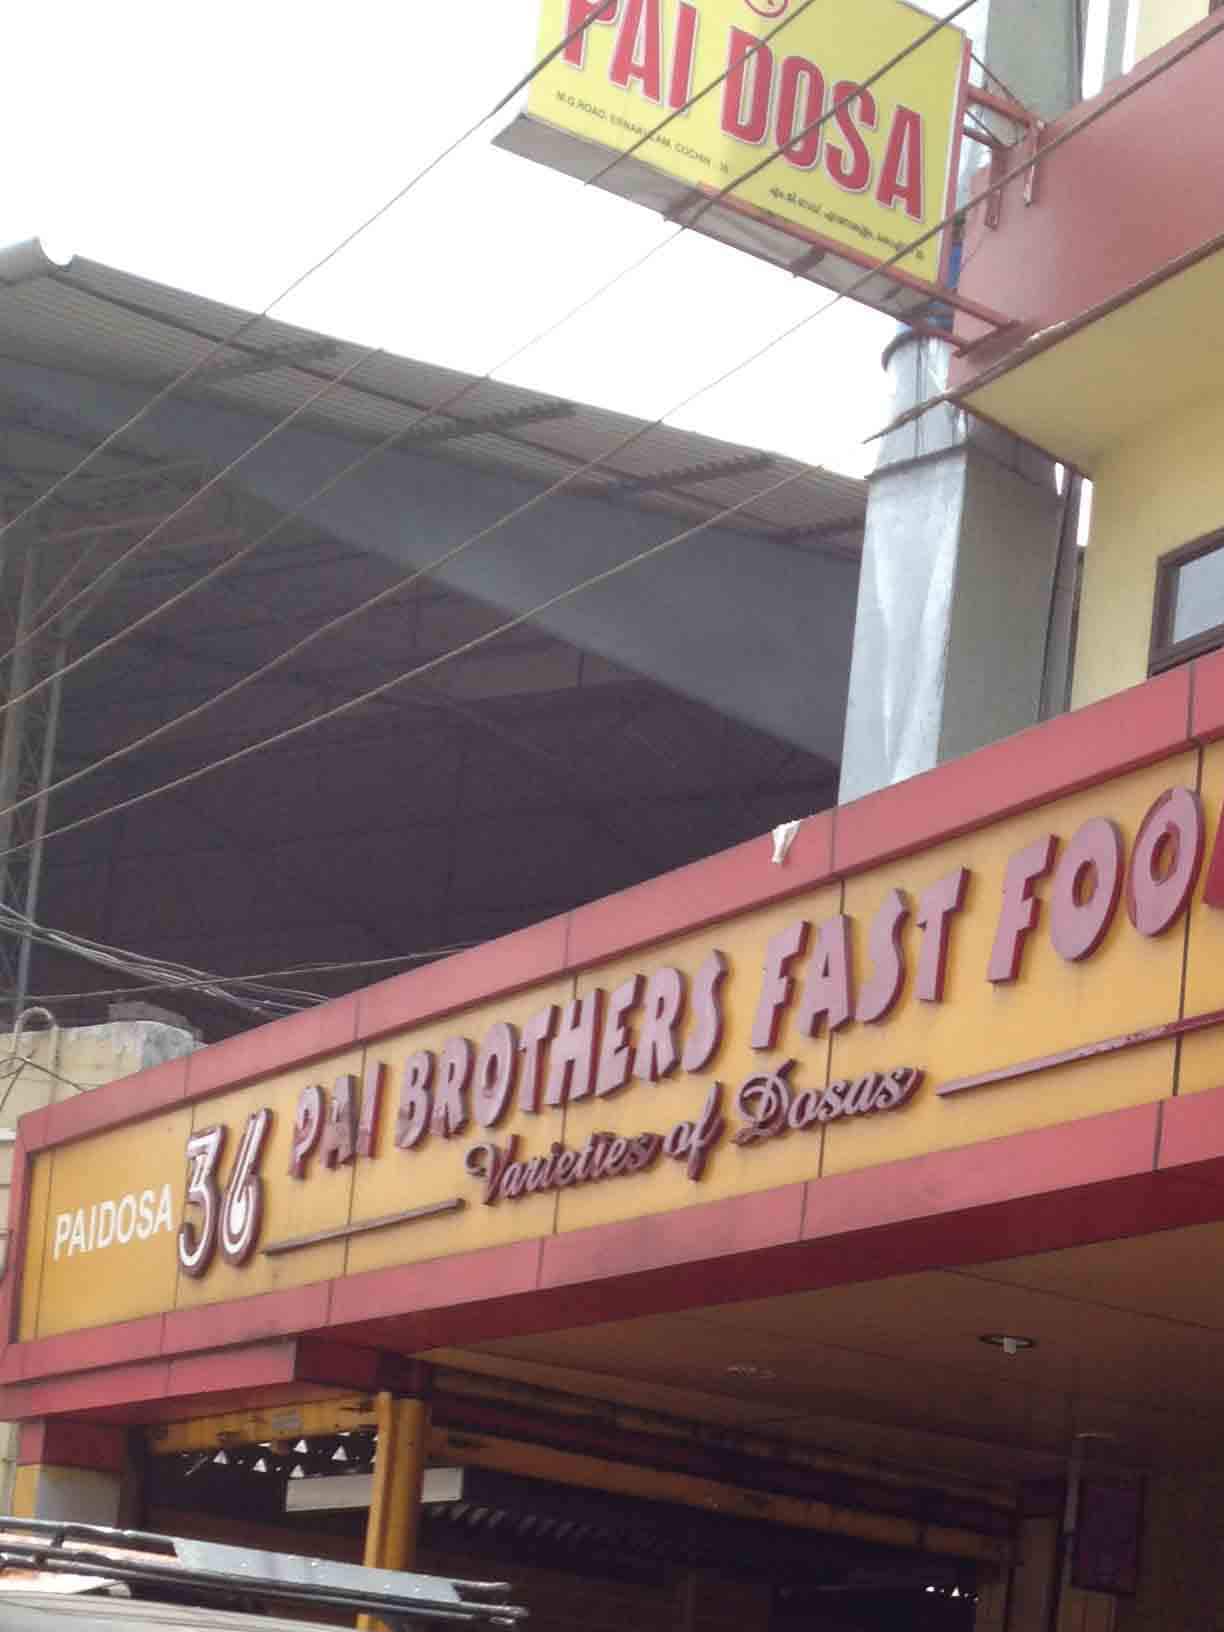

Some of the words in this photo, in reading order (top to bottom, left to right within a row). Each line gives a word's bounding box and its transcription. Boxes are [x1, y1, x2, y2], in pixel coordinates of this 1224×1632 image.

[561, 0, 699, 115] PAI
[720, 24, 924, 223] DOSA
[289, 1061, 388, 1180] PAI
[394, 948, 729, 1150] BROTHERS
[750, 867, 970, 1050] FAST
[465, 1126, 658, 1206] Varieties
[663, 1082, 724, 1182] of
[731, 1058, 926, 1147] Dosas
